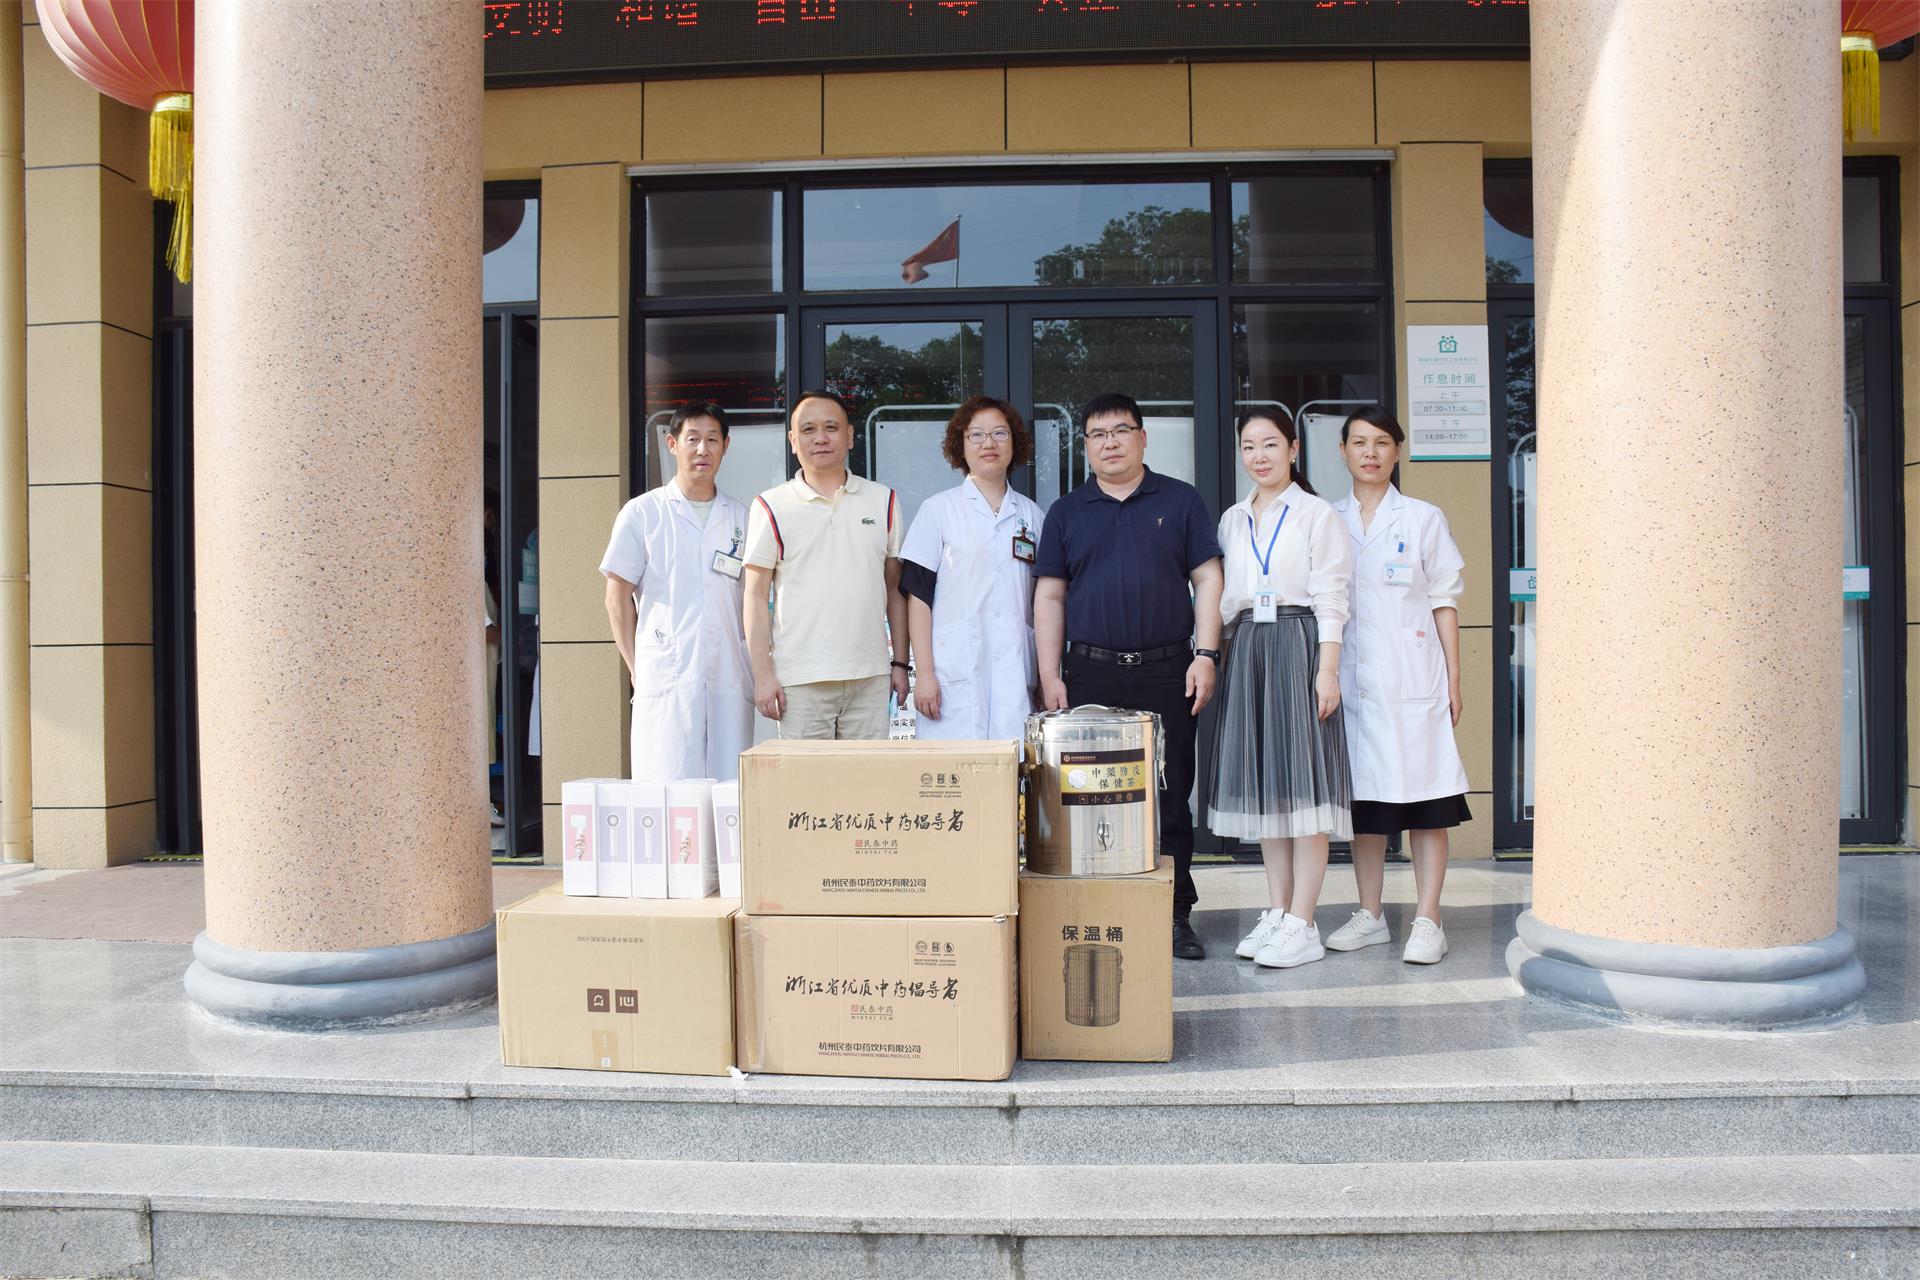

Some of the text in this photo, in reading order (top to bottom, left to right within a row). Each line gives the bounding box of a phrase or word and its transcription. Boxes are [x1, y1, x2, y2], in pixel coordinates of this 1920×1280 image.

[1423, 373, 1476, 385] 作息时间
[788, 808, 965, 832] 浙江省优质中药倡导者
[822, 878, 927, 888] 杭州民泰中药饮片有限公司
[1061, 925, 1124, 942] 保温桶
[785, 975, 959, 1000] 浙江省优质中药倡导者
[818, 1042, 921, 1053] 杭州民泰中药饮片有限公司
